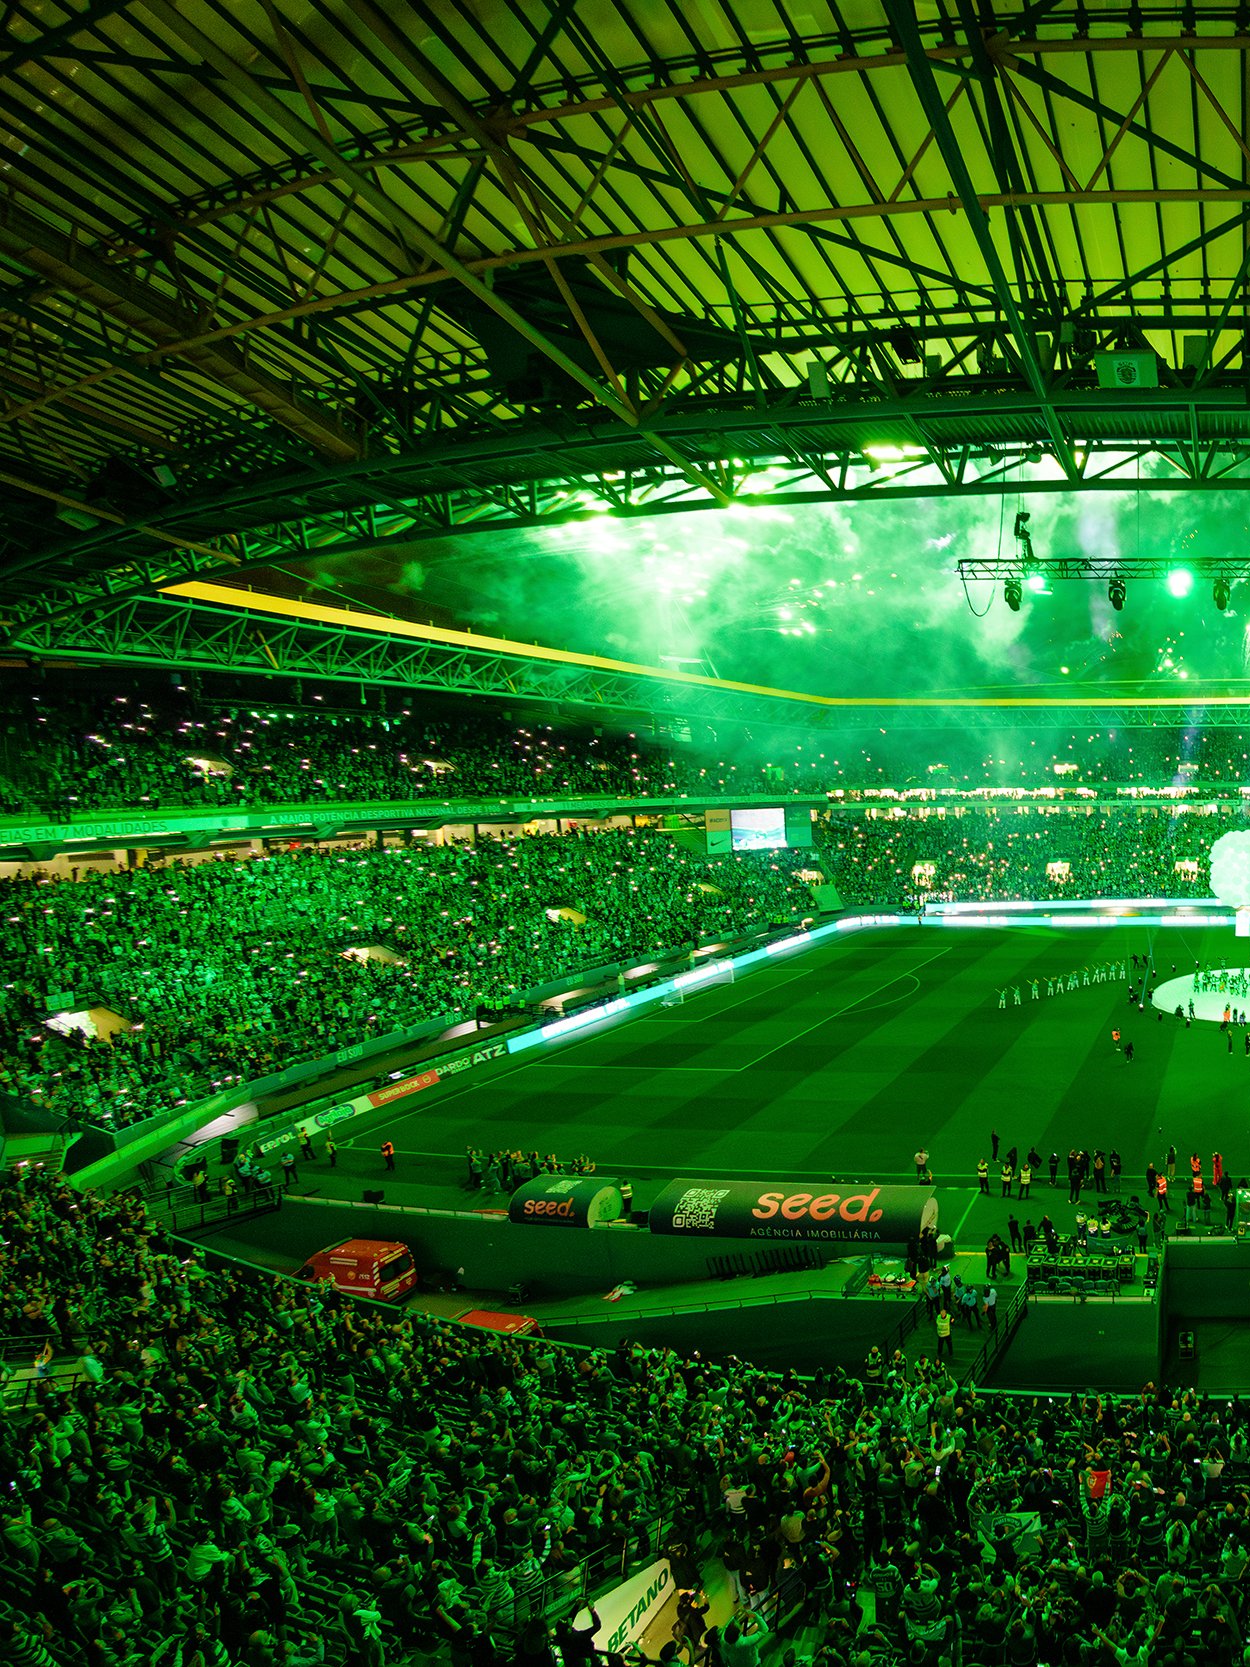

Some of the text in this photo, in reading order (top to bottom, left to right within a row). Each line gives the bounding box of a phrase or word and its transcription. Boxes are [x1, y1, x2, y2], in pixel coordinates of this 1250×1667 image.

[279, 813, 311, 824] MAIOR
[361, 807, 414, 819] DESPORTIVA
[416, 806, 456, 816] NACIONAL
[35, 827, 57, 840] EM
[61, 826, 69, 839] 7
[73, 820, 168, 837] MODALIDADES
[435, 1057, 471, 1076] DARDO
[472, 1044, 507, 1065] ATZ
[523, 1197, 576, 1217] seed.
[752, 1188, 883, 1222] seed.
[750, 1226, 881, 1239] AGÊNCIA IMOBILIÁRIA
[607, 1567, 669, 1653] BETANO
